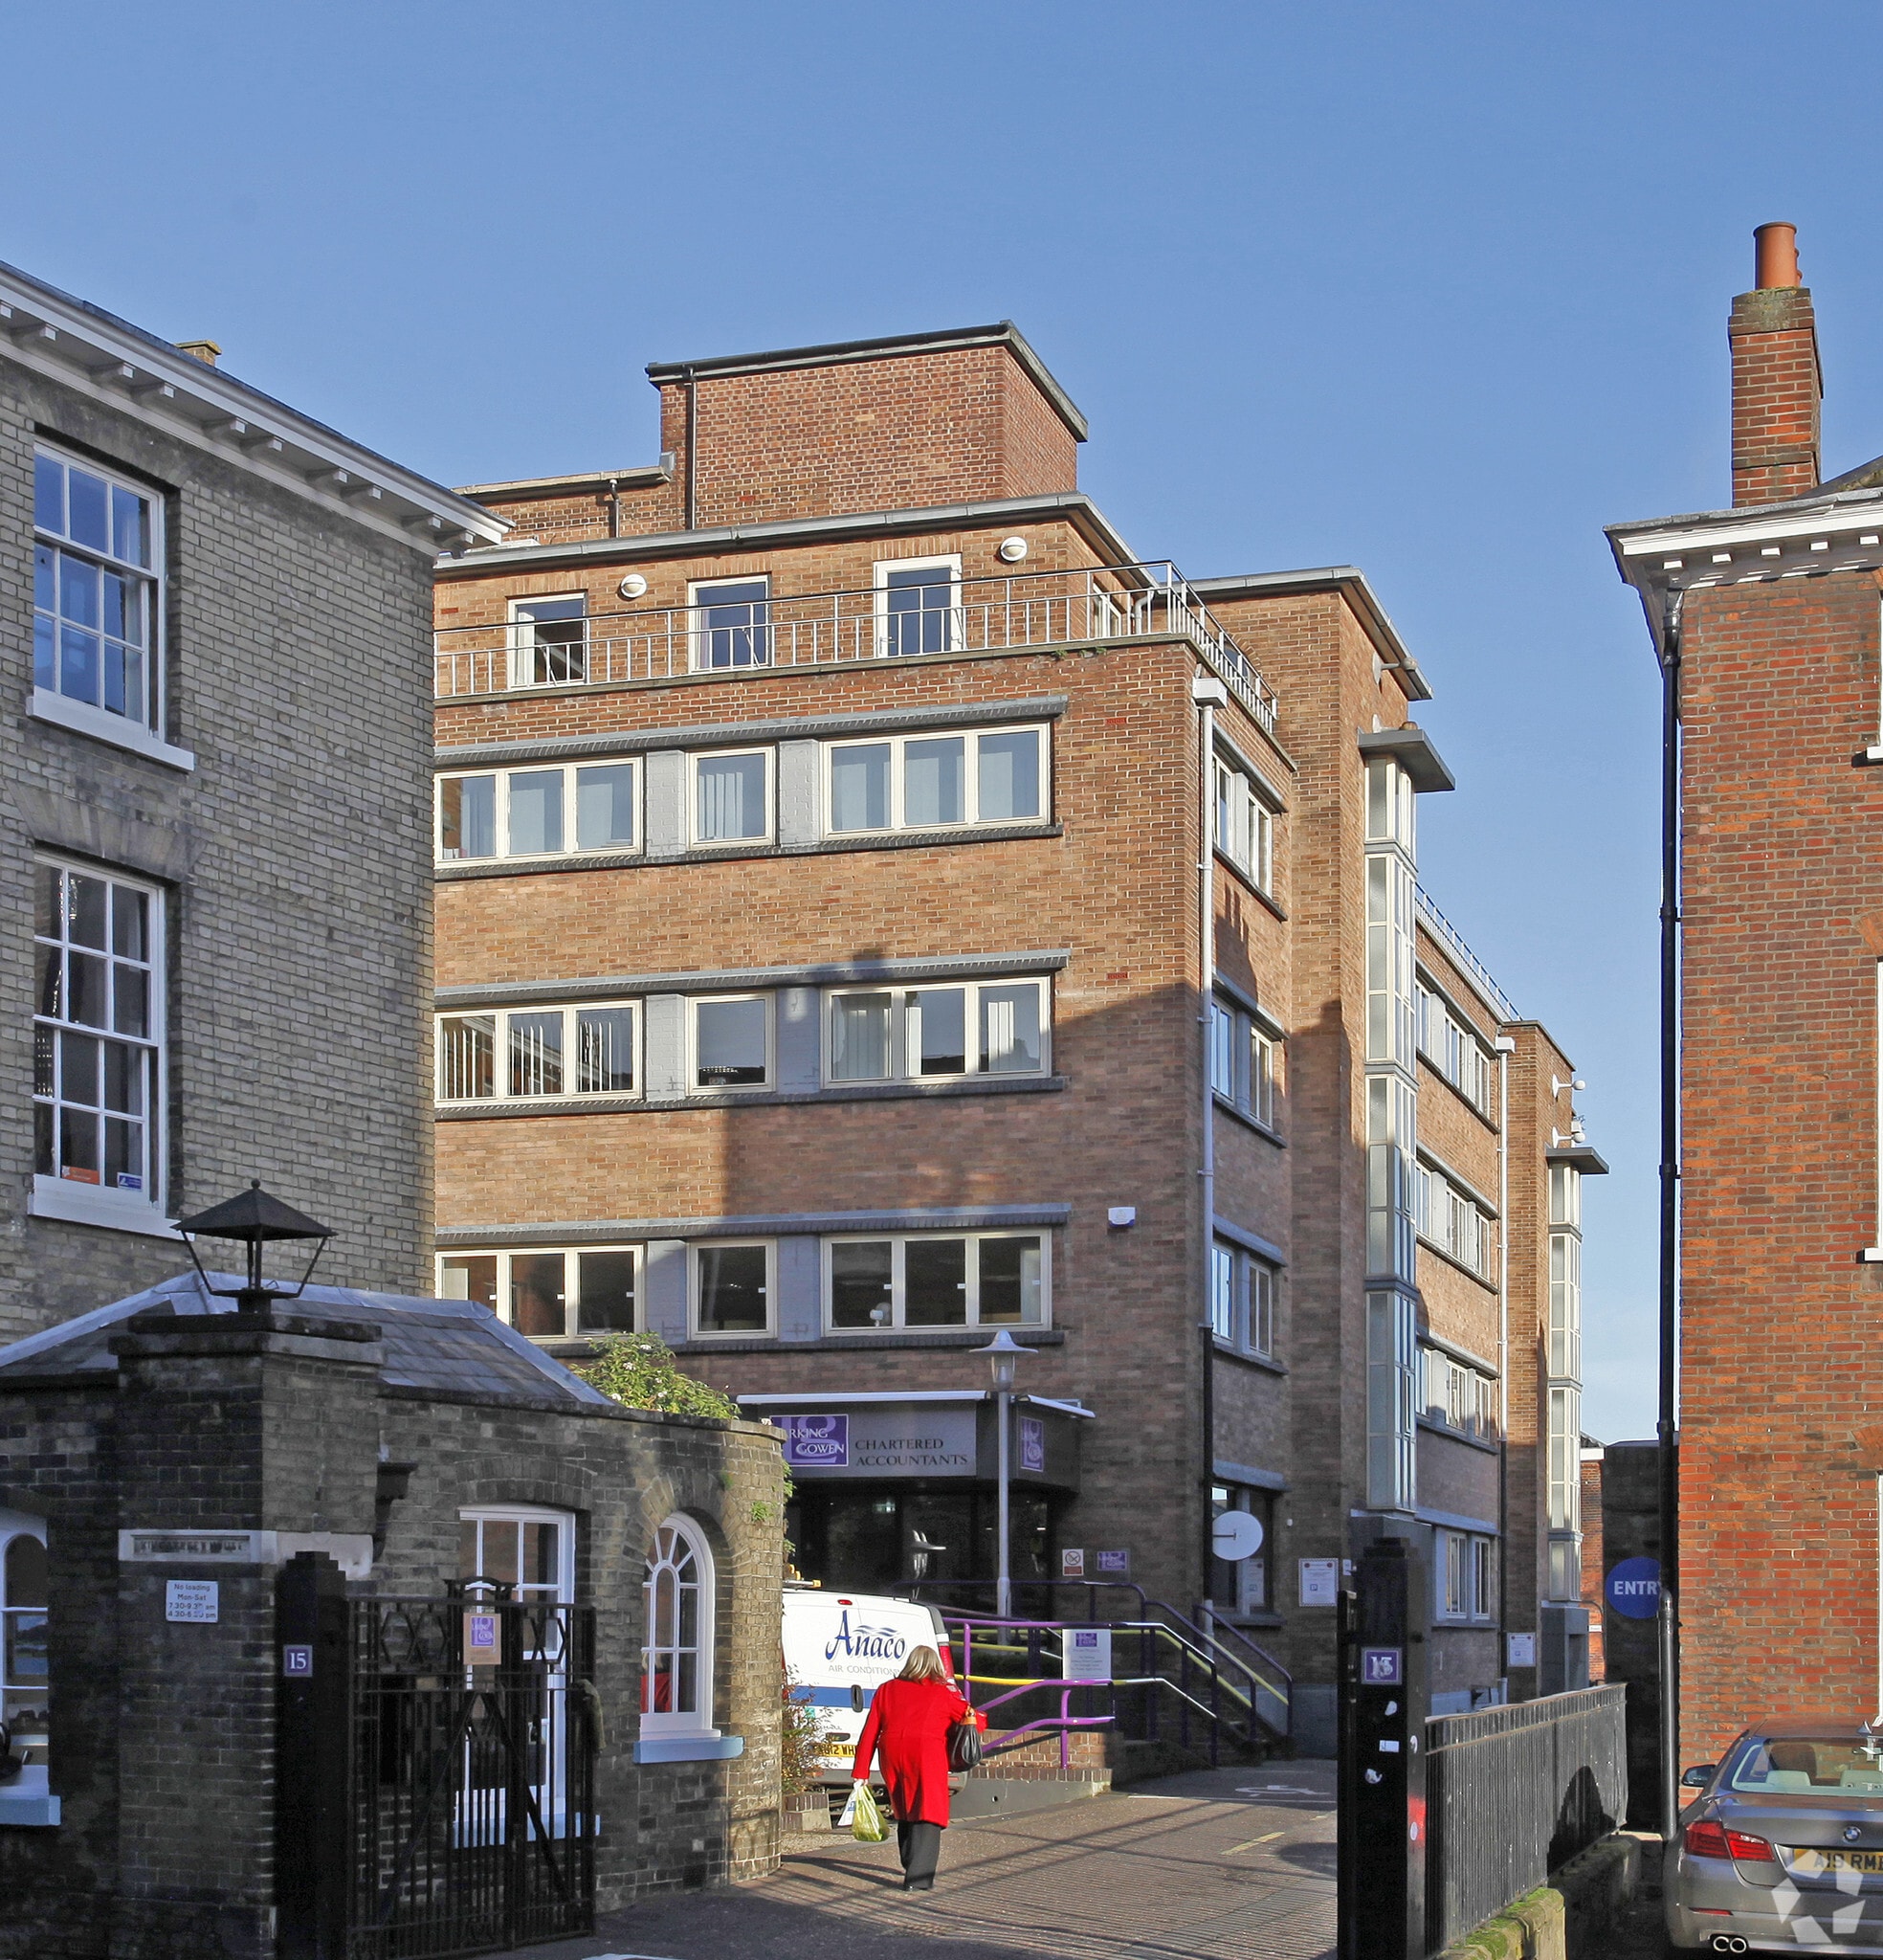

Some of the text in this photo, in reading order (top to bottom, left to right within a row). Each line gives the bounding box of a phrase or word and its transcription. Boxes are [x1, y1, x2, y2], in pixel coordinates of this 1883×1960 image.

[789, 1428, 829, 1438] RKING
[796, 1442, 845, 1455] GOWEN
[854, 1438, 943, 1450] CHARTERED
[855, 1454, 968, 1466] ACCOUNTANTS
[825, 1609, 906, 1660] Anaco
[290, 1652, 307, 1670] 15
[847, 1666, 900, 1676] CONDITION
